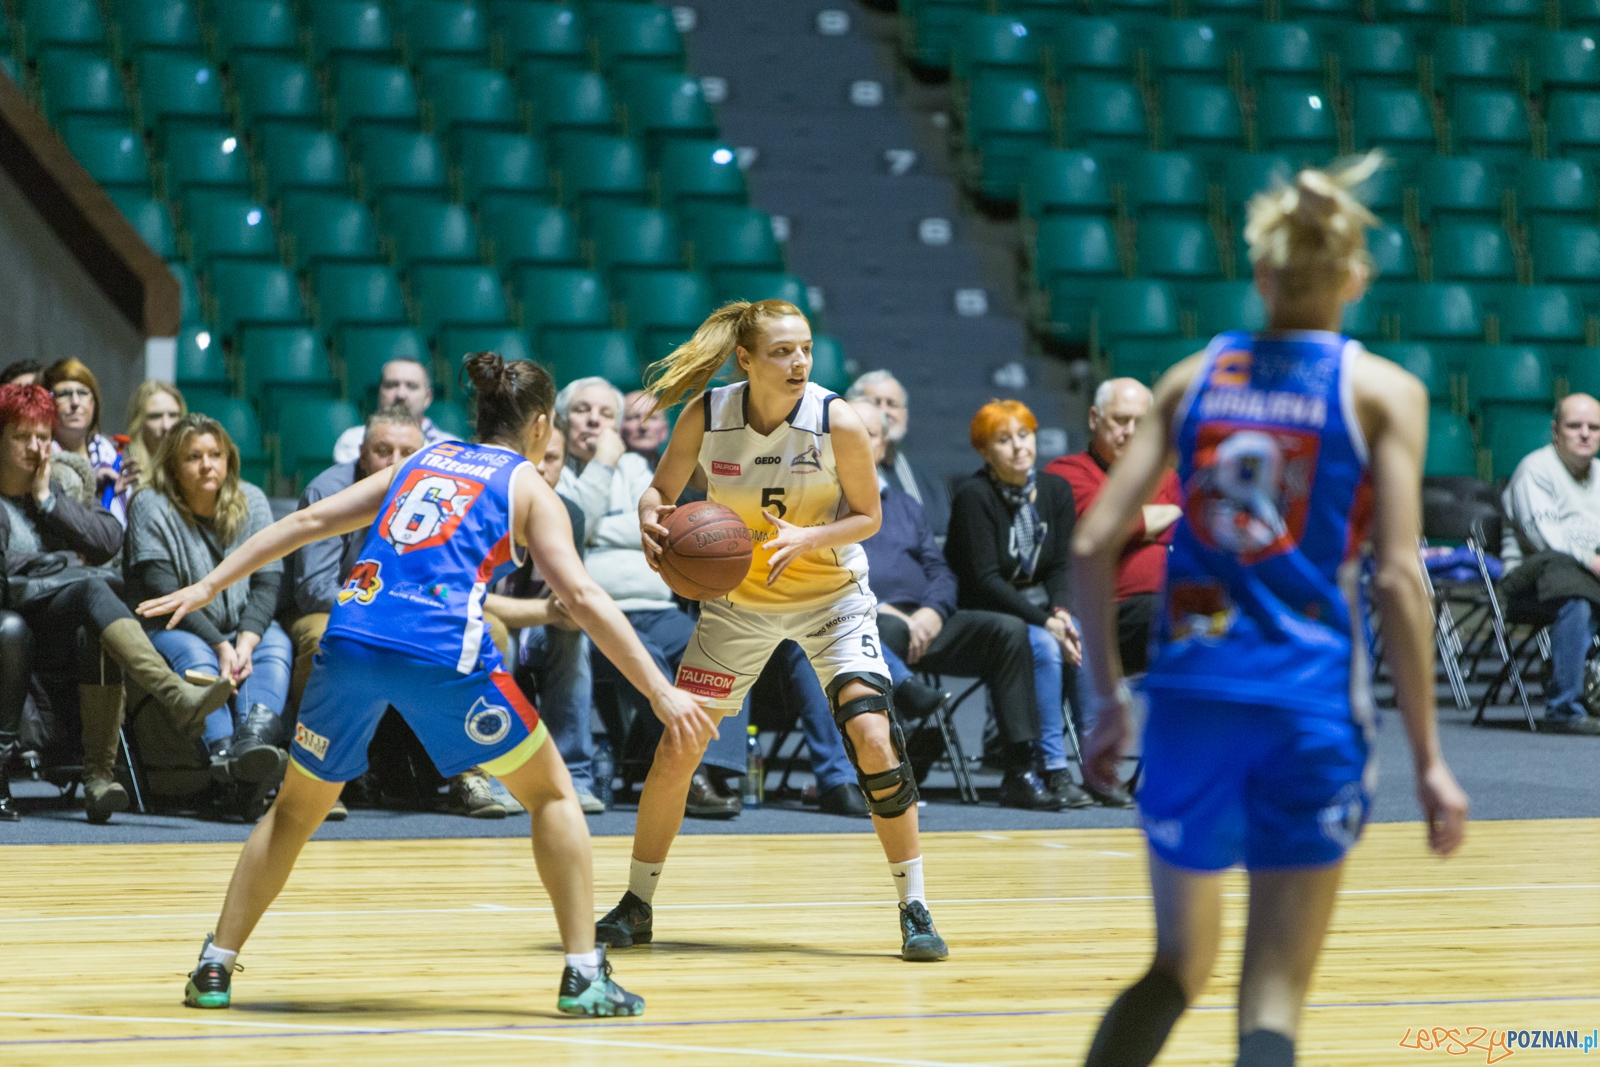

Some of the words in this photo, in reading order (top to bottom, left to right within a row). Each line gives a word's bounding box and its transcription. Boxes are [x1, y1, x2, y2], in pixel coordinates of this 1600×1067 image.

[886, 149, 917, 176] 7
[420, 453, 498, 480] TRZECIAK
[713, 462, 740, 471] TAURON
[754, 456, 782, 465] GEDO
[388, 475, 459, 546] 6
[761, 487, 787, 520] 5
[861, 634, 879, 659] 5
[681, 669, 734, 689] TAURON
